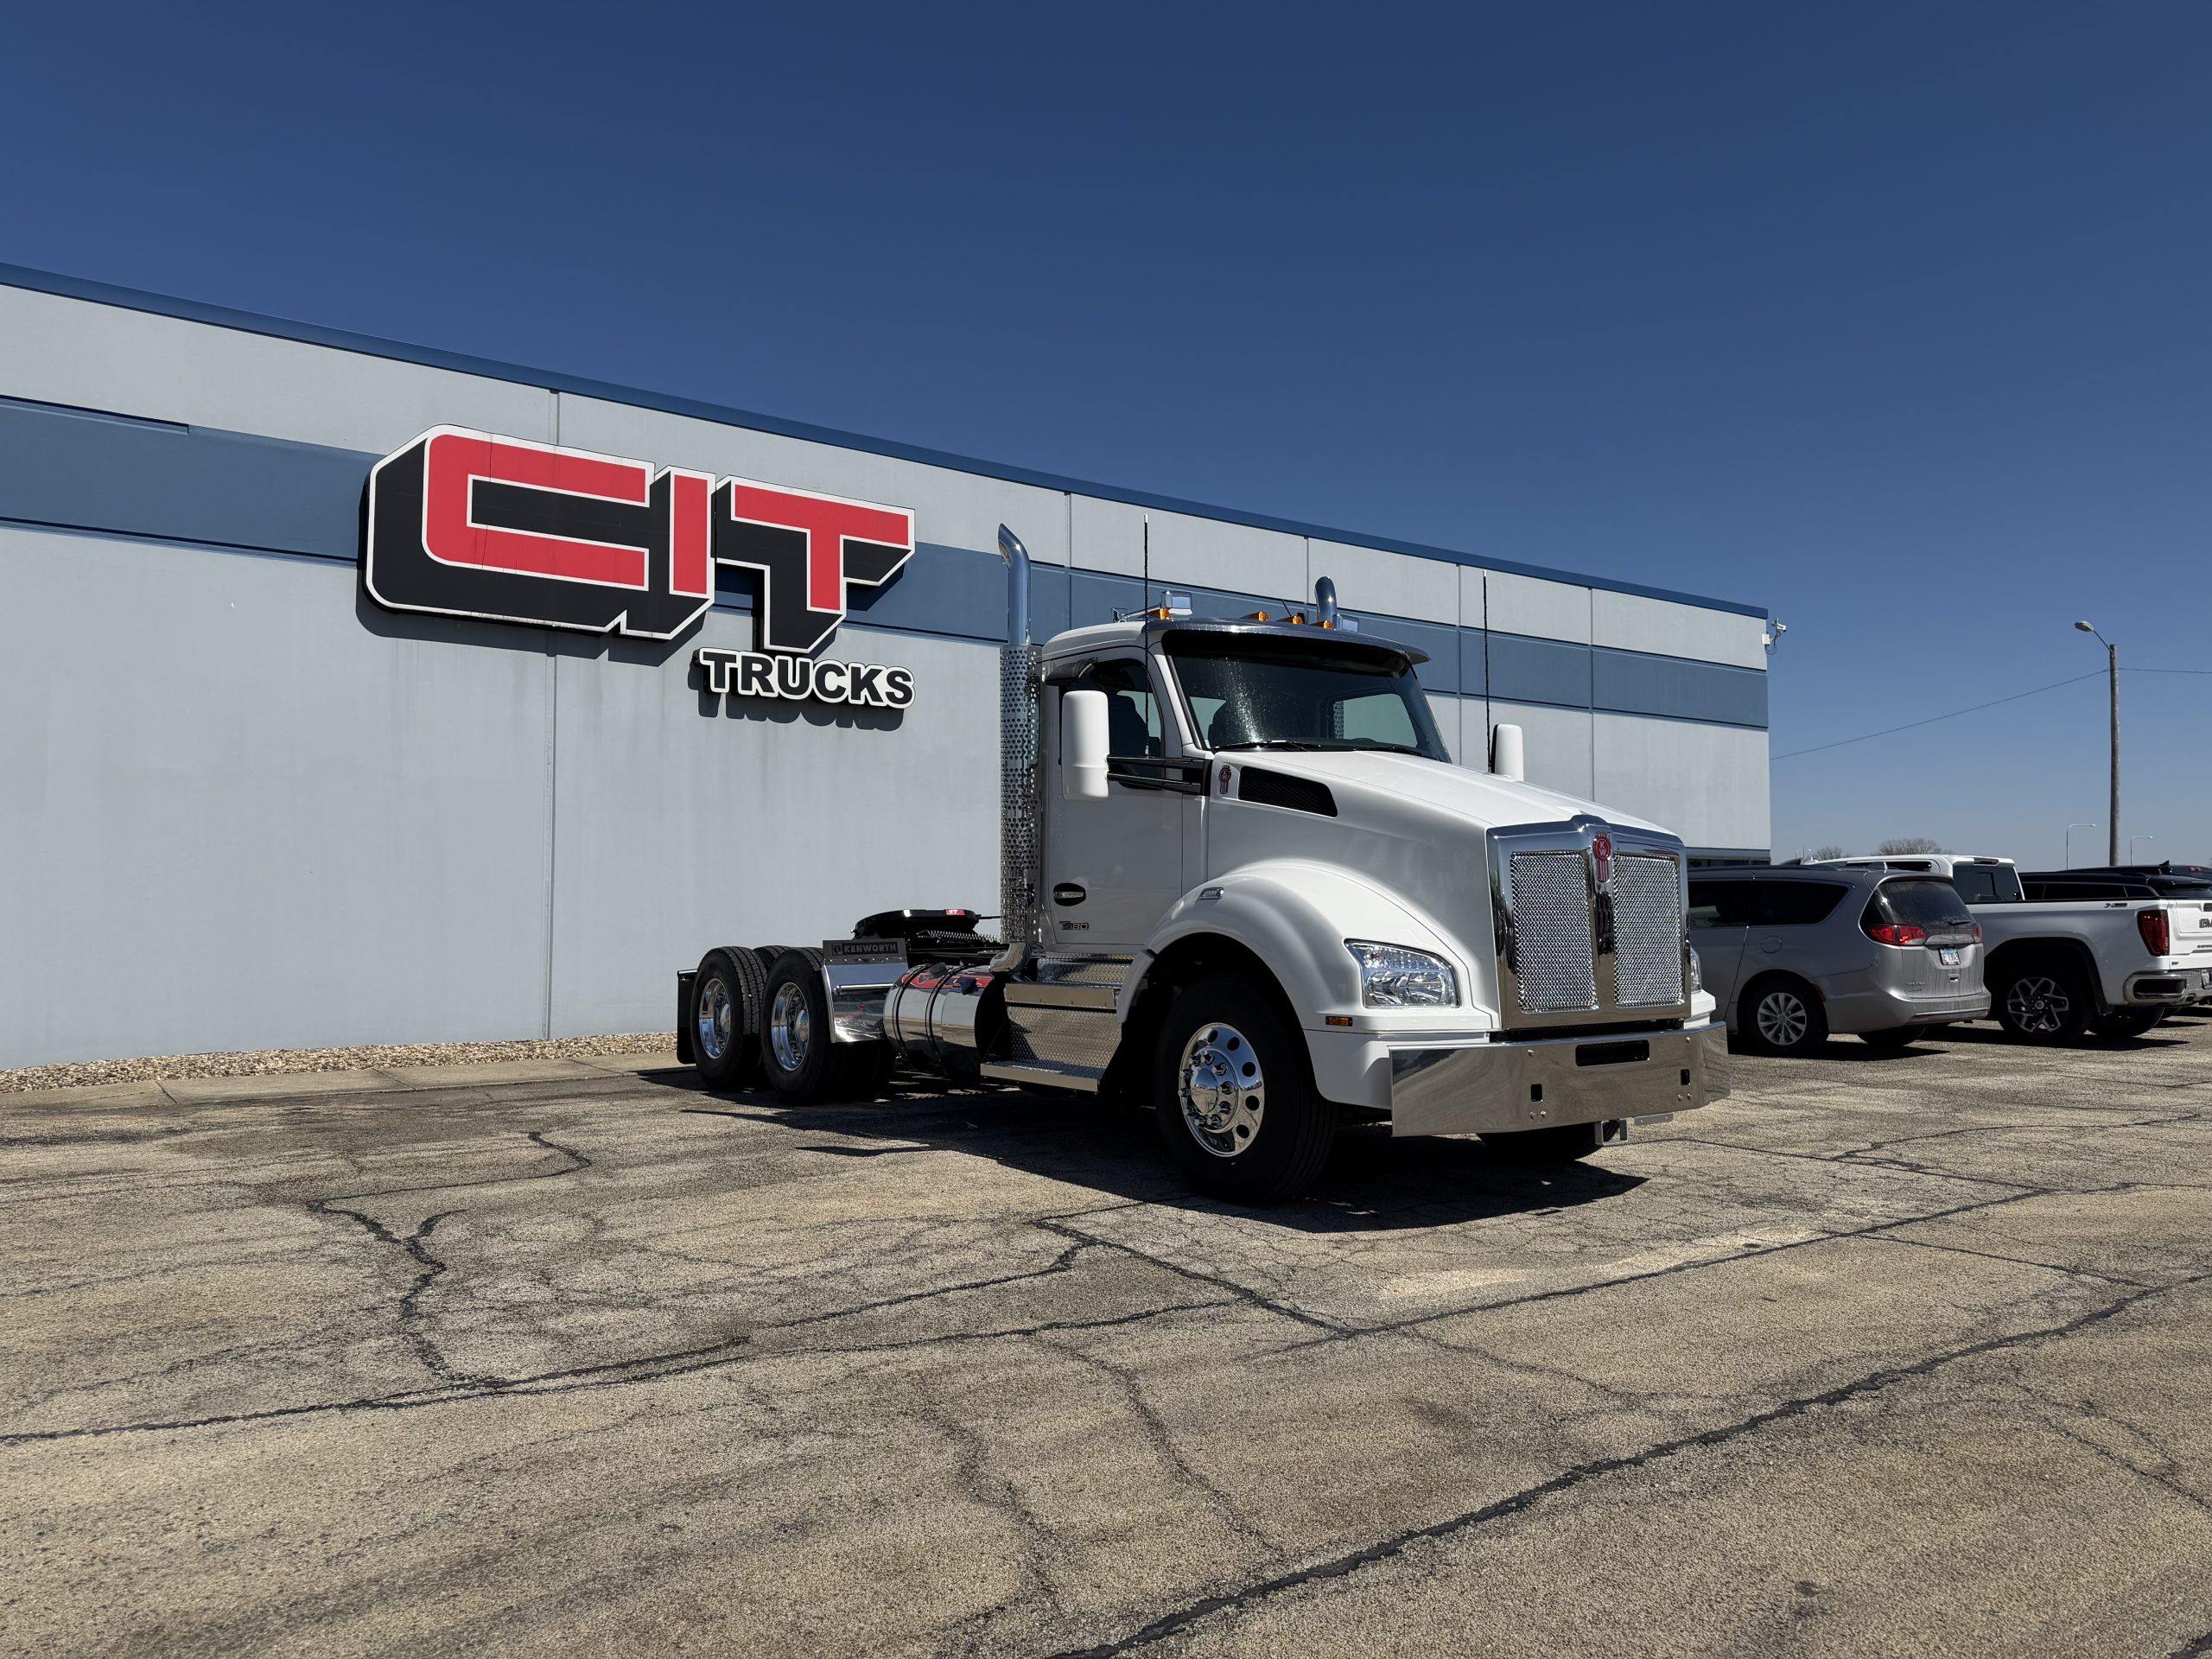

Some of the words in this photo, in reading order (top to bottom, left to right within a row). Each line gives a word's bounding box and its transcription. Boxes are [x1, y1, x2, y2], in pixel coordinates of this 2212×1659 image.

[367, 424, 915, 653] CIT
[700, 647, 915, 709] TRUCKS
[843, 943, 897, 954] KENWORTH
